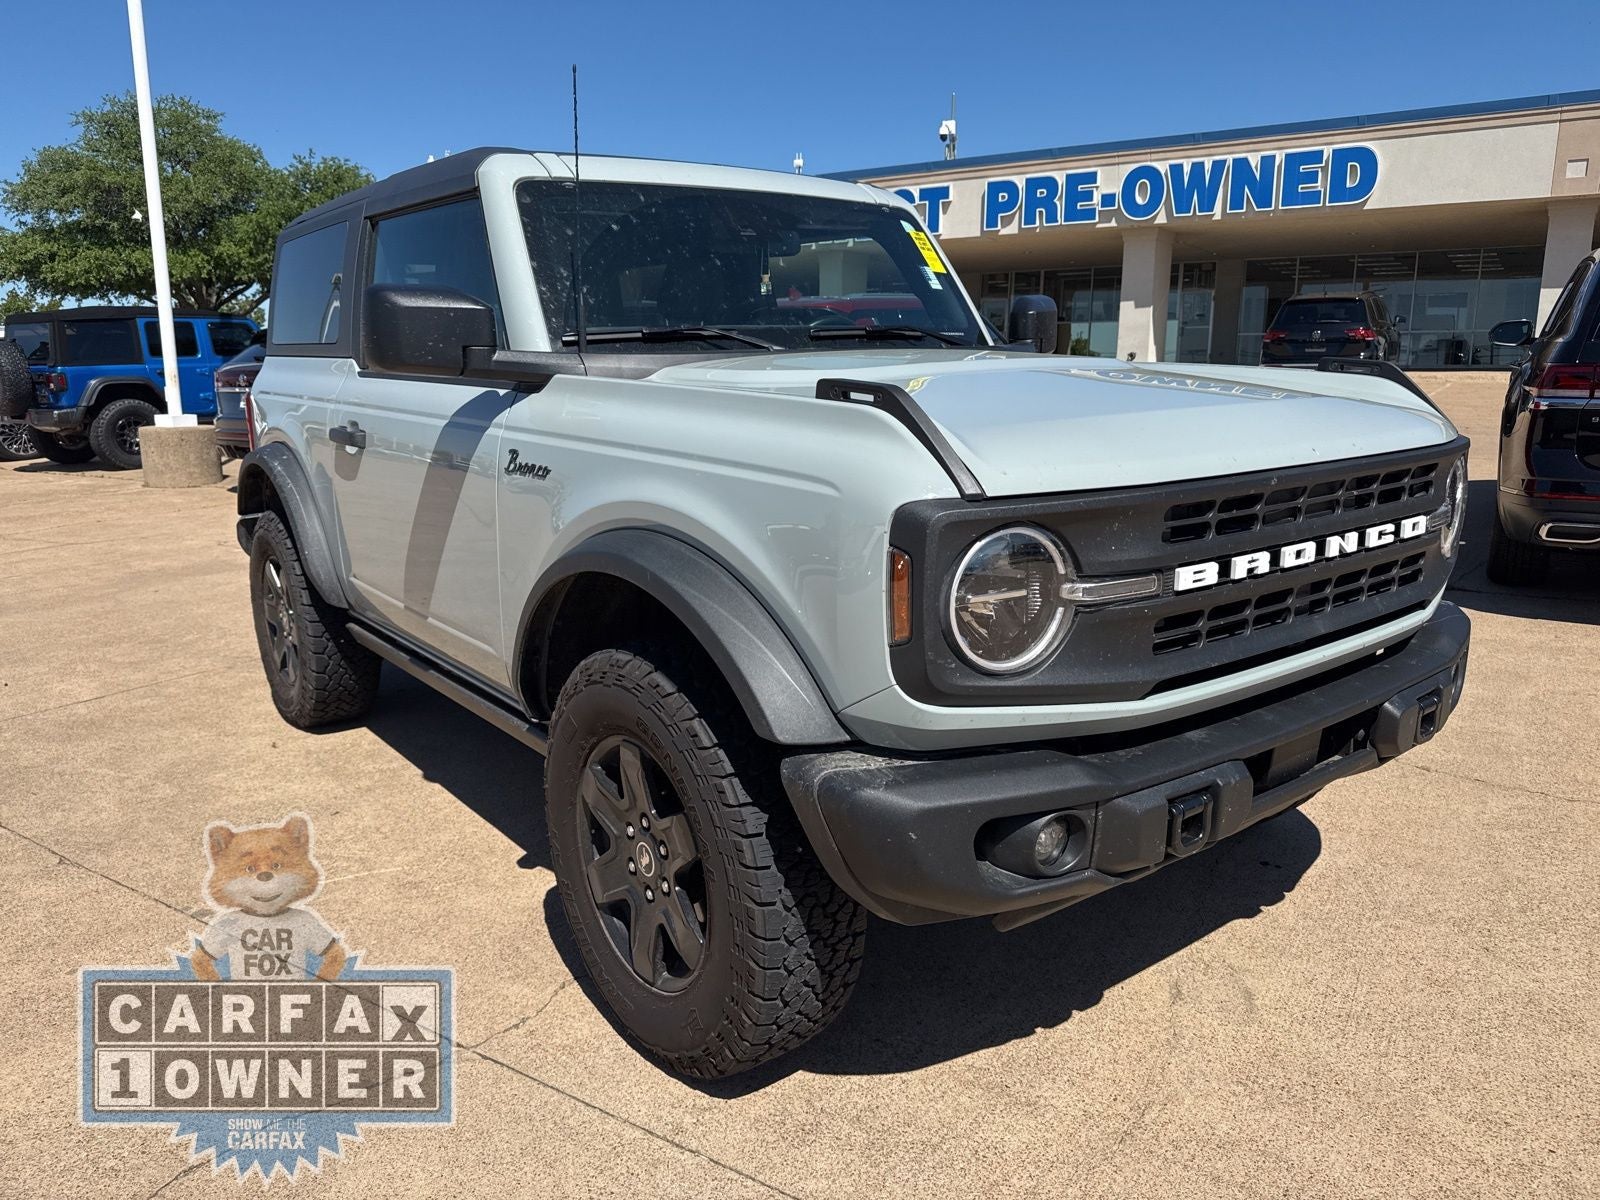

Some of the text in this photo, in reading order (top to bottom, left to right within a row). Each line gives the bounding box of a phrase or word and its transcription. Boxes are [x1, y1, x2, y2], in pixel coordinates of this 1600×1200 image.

[893, 145, 1380, 234] T PRE-OWNED
[504, 448, 552, 481] Bronco
[1174, 515, 1427, 591] BRONCO
